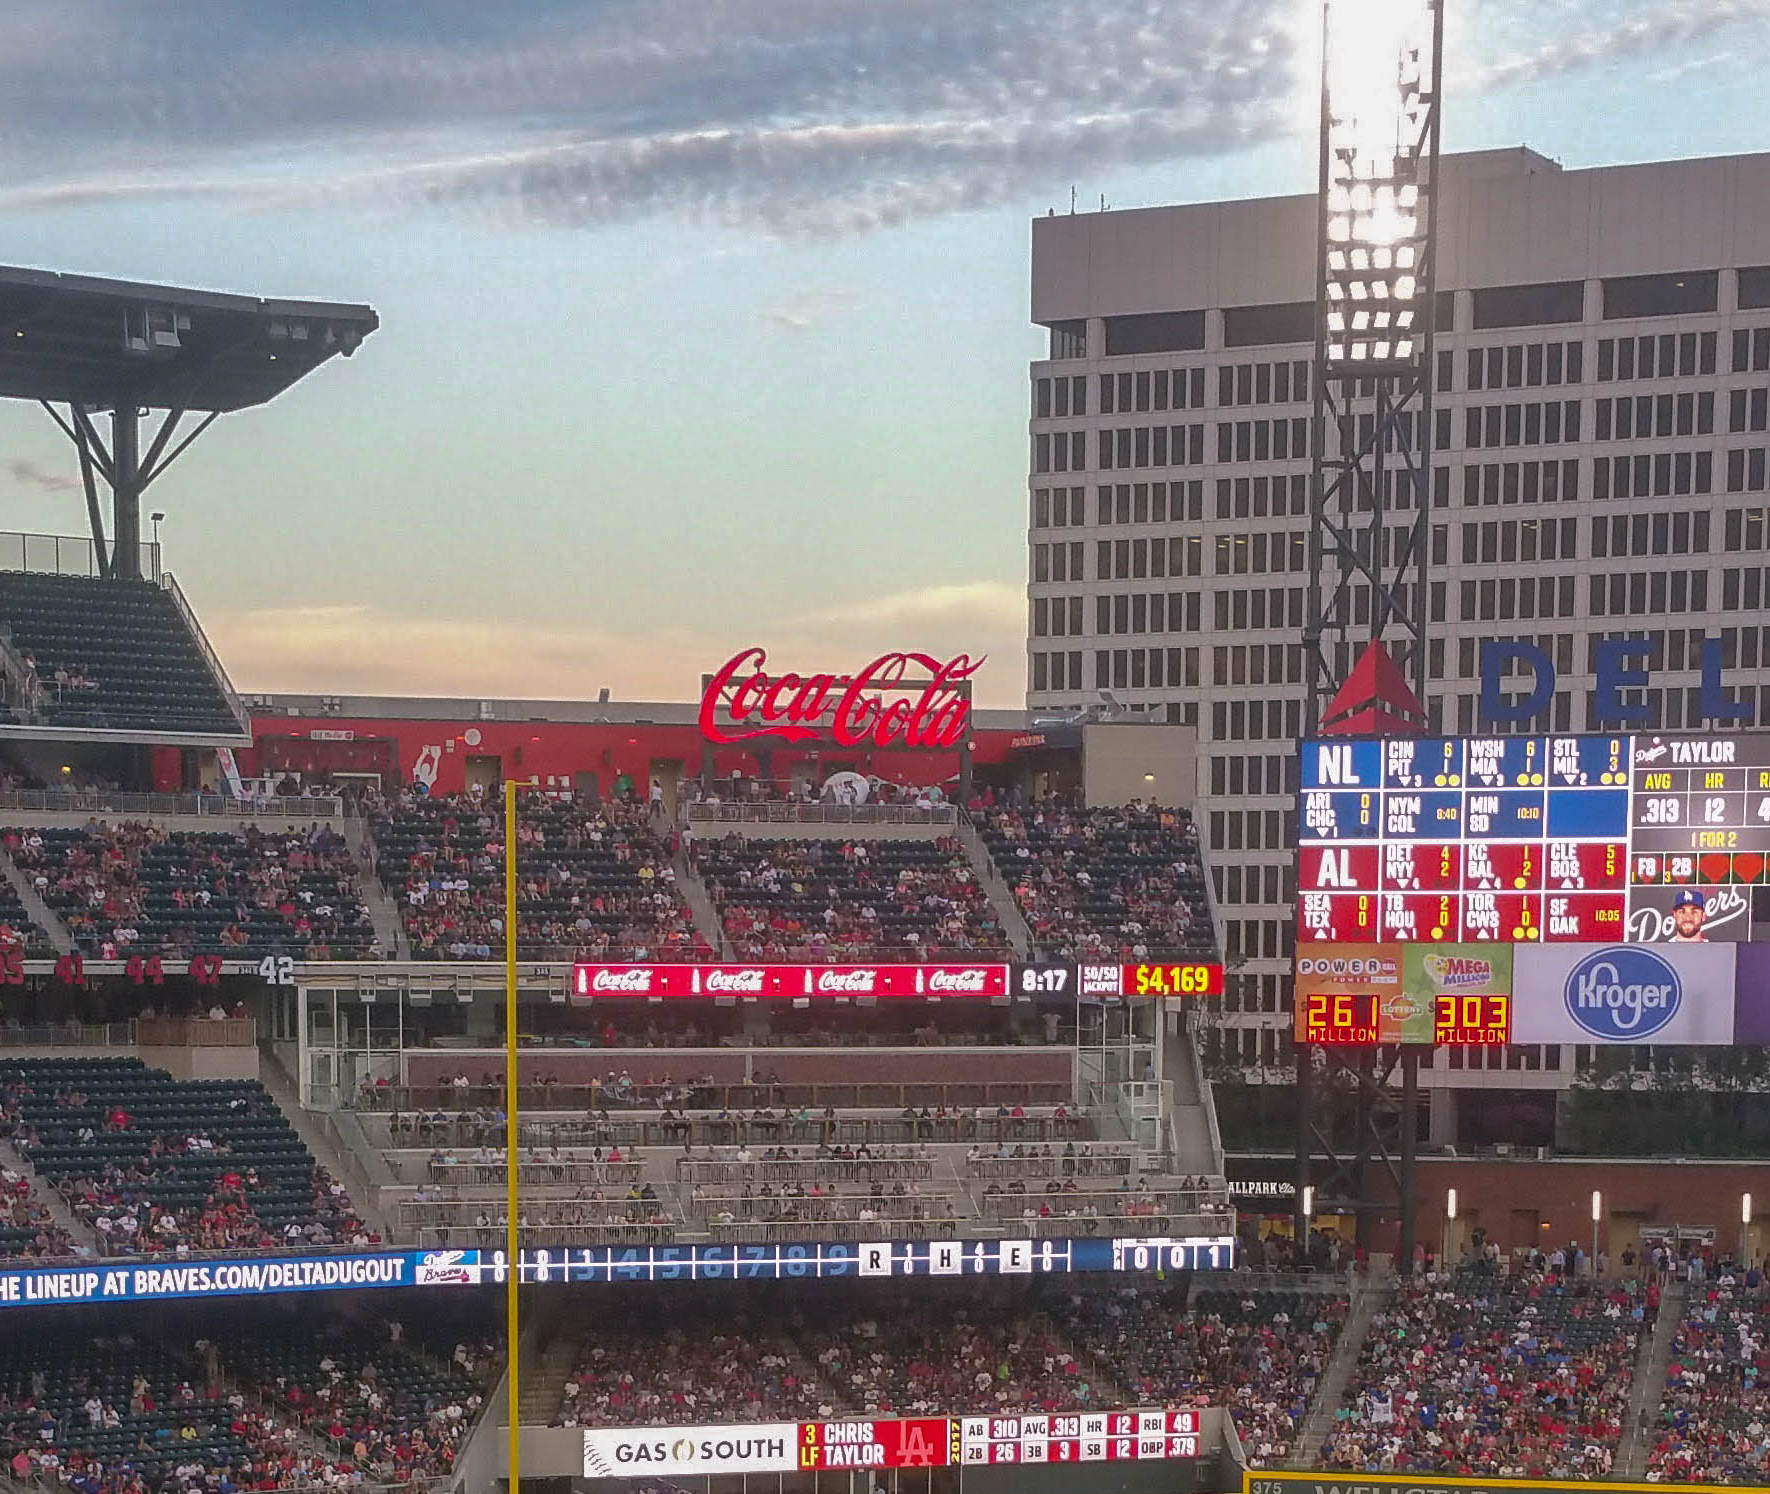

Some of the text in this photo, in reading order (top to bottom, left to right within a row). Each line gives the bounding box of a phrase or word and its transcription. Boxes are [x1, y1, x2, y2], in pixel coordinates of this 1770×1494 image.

[699, 647, 988, 747] Coca-Cola
[1389, 741, 1413, 759] CIN
[1471, 740, 1503, 758] WSH
[1554, 739, 1579, 757] STL
[1671, 741, 1734, 763] TAYLOR
[1319, 746, 1359, 785] NL
[1645, 773, 1671, 790] AVG
[1705, 773, 1724, 788] HR
[1641, 798, 1679, 823] .313
[1705, 798, 1725, 822] 12
[1317, 849, 1357, 887] AL
[1595, 910, 1620, 922] 10:05
[126, 955, 163, 984] 44
[189, 955, 222, 984] 47
[259, 956, 295, 984] 42
[1022, 966, 1118, 991] 8:17 50/50
[1136, 966, 1208, 995] $4,169
[1084, 982, 1117, 993] JACKPOT
[1577, 958, 1672, 1030] Kroger
[1309, 996, 1377, 1027] 261
[1437, 997, 1507, 1028] 303
[1309, 1028, 1376, 1042] MILLION
[1437, 1029, 1506, 1042] MILLION
[869, 1251, 881, 1269] R
[941, 1249, 951, 1267] H
[1011, 1248, 1020, 1266] E
[26, 1273, 98, 1300] LINEUP
[104, 1272, 129, 1295] AT
[135, 1259, 405, 1294] BRAVES.COM/DELTADUGOUT
[806, 1423, 874, 1443] 3 CHRIS
[615, 1437, 784, 1463] GAS SOUTH
[801, 1444, 884, 1467] LF TAYLOR
[1253, 1482, 1283, 1494] 375
